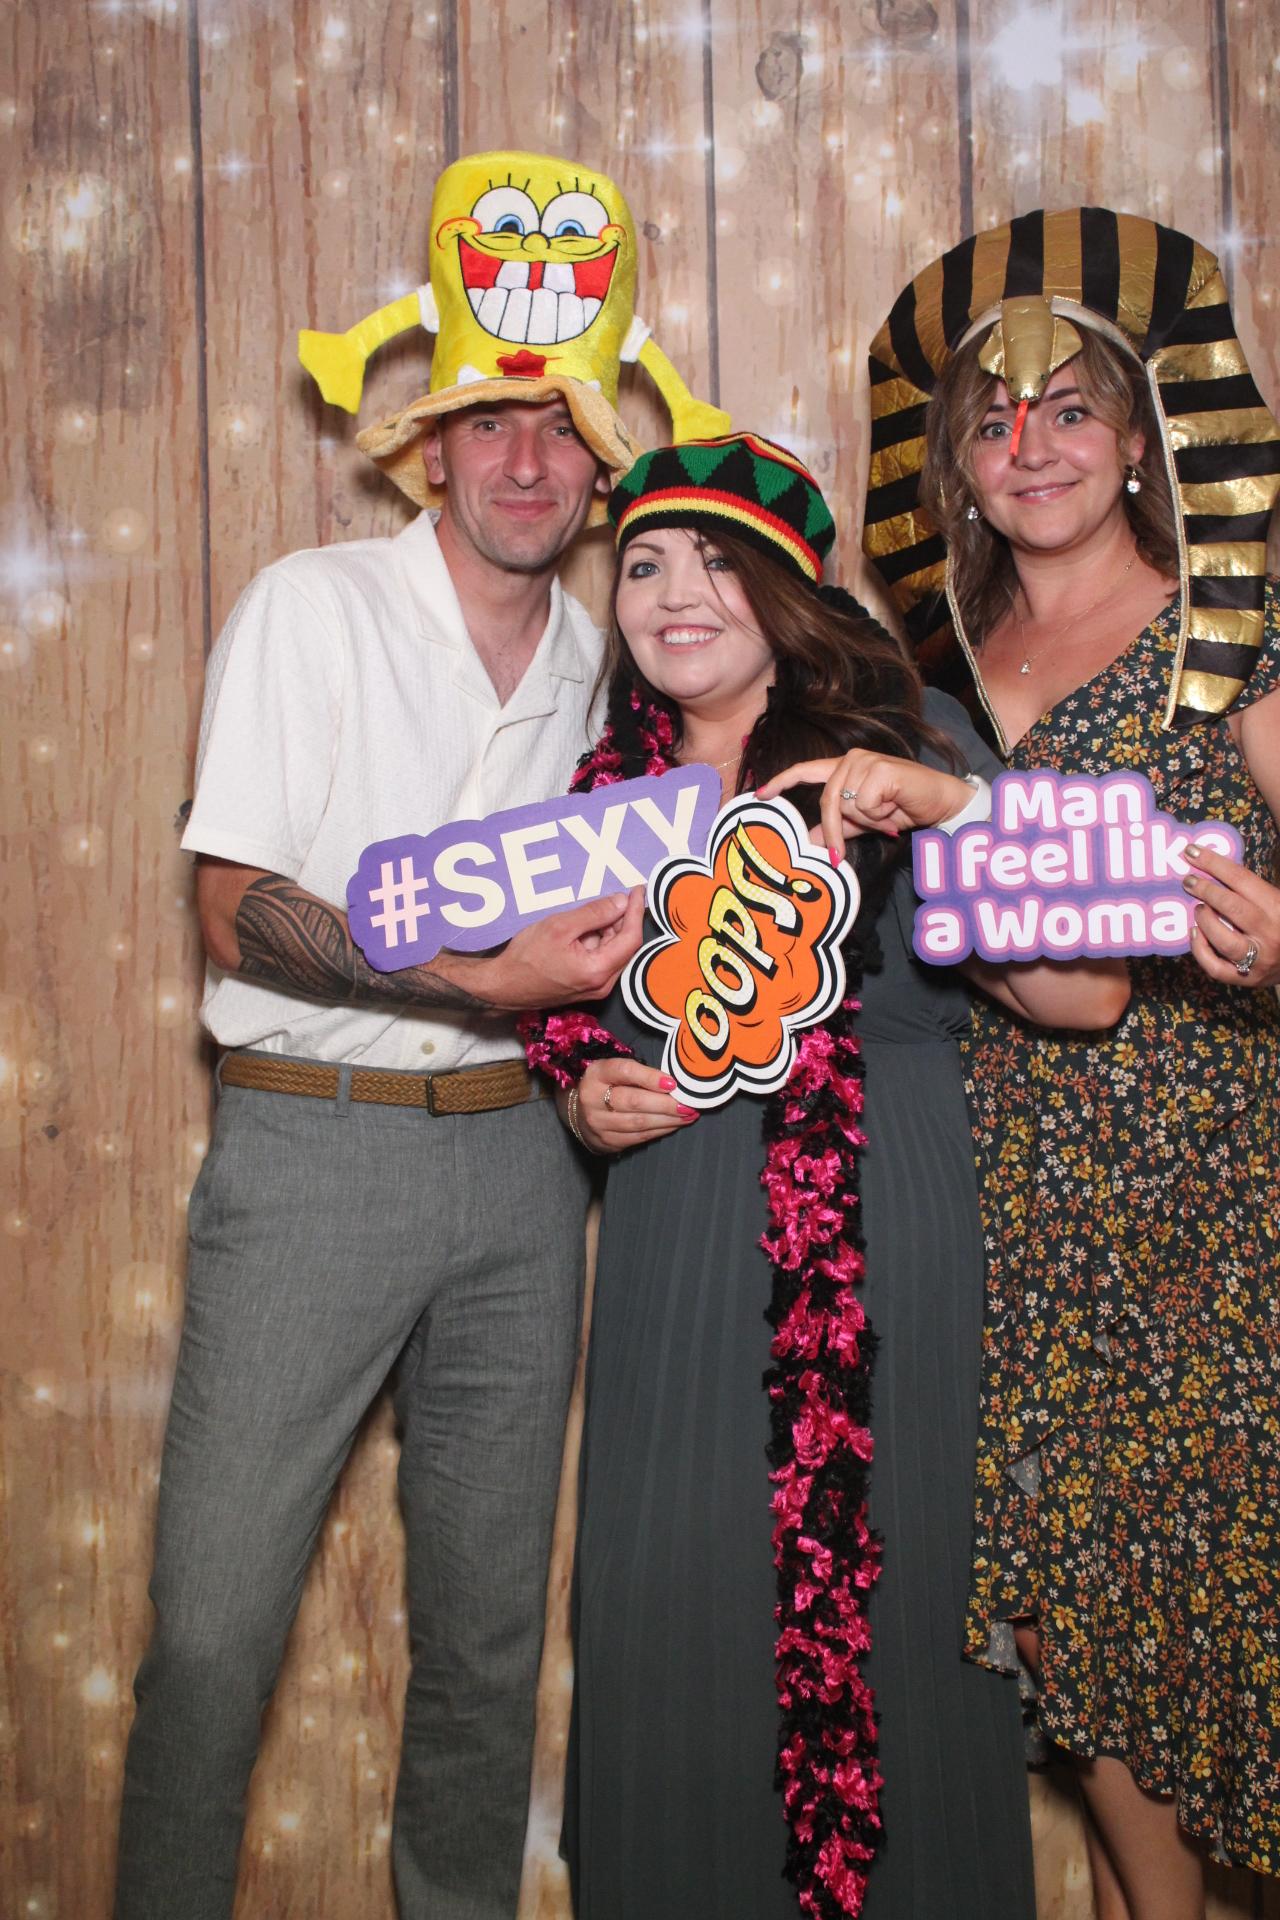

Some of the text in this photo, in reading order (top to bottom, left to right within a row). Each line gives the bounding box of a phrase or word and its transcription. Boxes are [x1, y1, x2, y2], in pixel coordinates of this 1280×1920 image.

[1003, 781, 1142, 831] Man
[368, 784, 701, 949] #SEXY
[924, 841, 941, 889] I
[960, 830, 1088, 887] feel
[684, 817, 821, 1056] OOPS!
[925, 899, 1203, 952] a Woma
